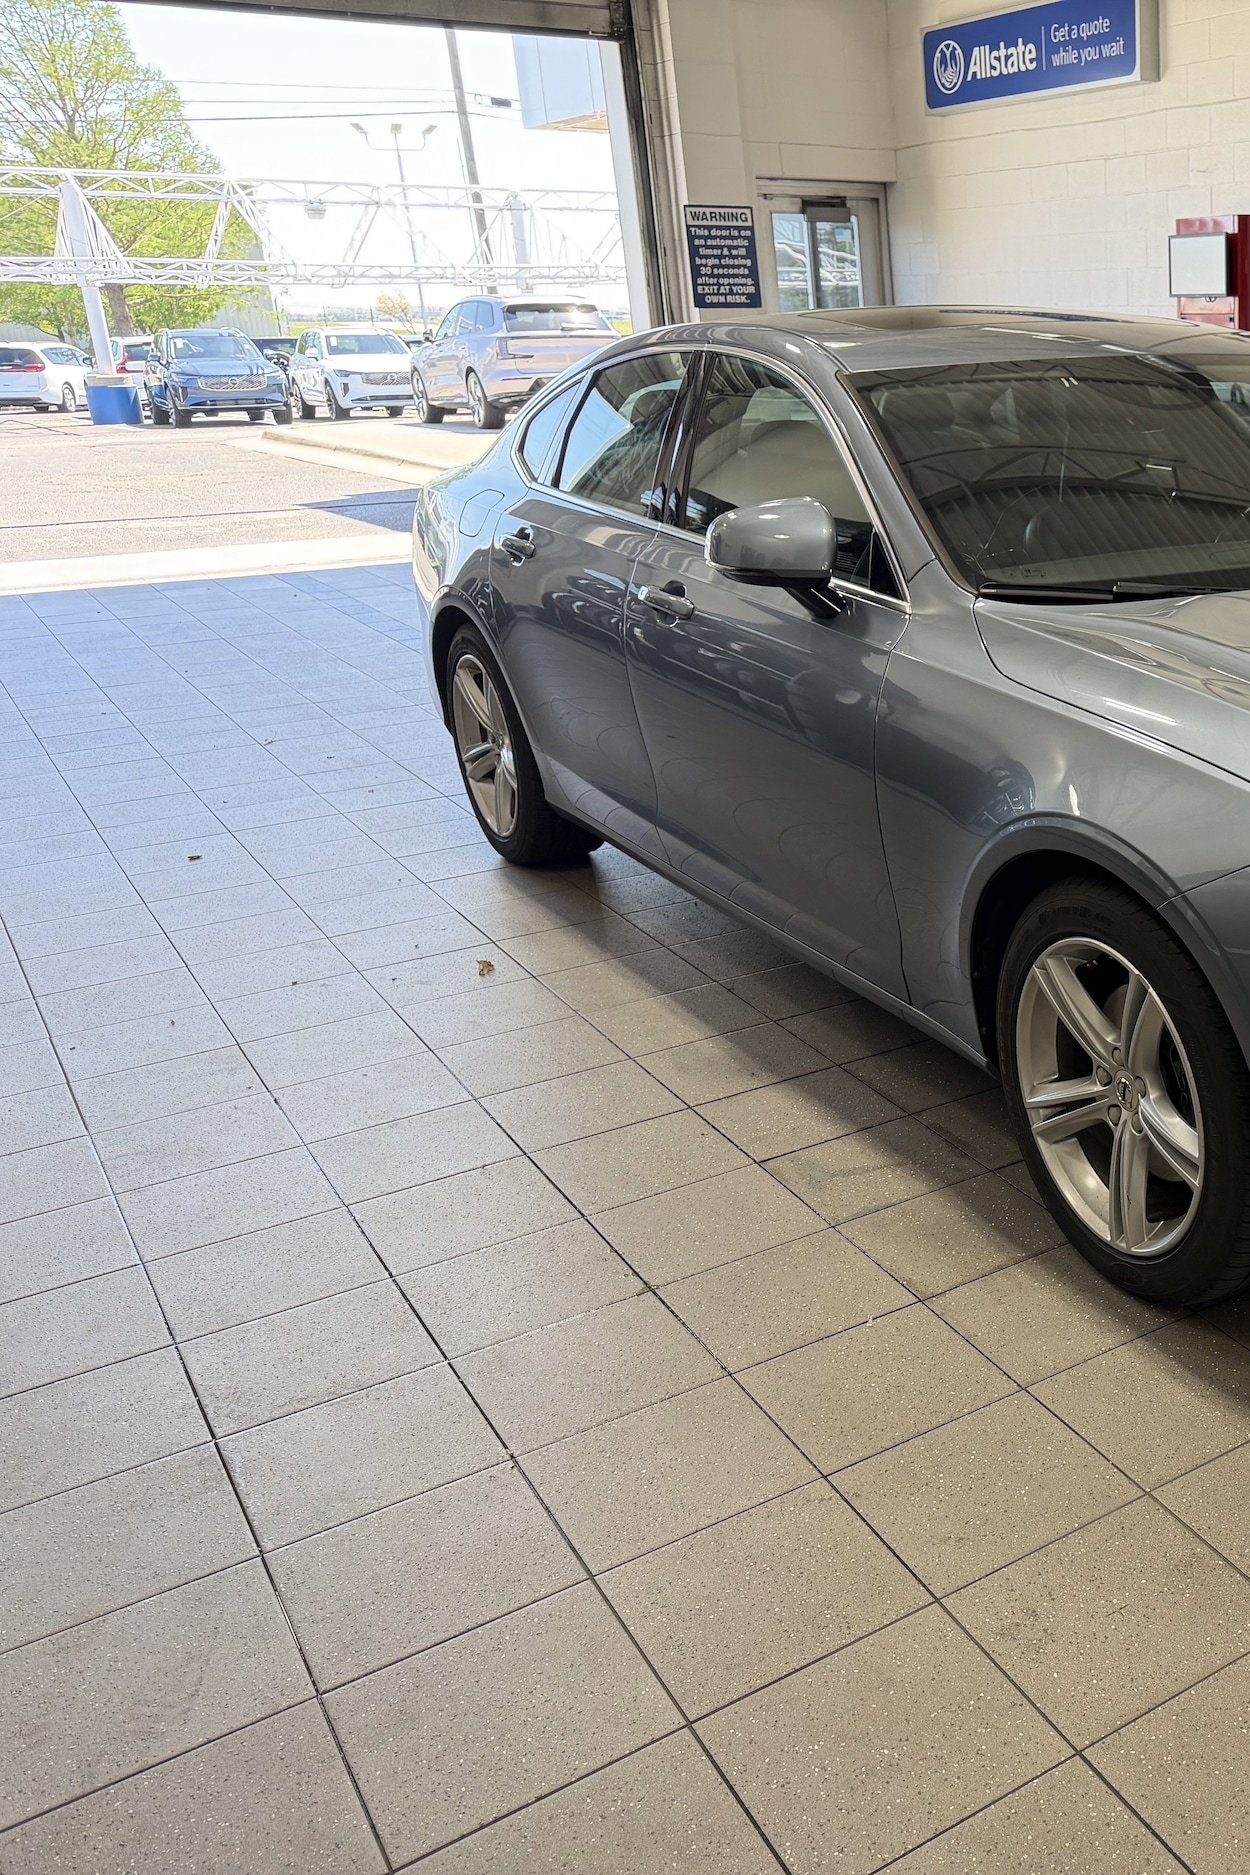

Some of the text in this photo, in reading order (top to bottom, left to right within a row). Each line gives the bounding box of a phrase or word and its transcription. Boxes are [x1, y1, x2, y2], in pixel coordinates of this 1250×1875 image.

[1050, 15, 1110, 43] Get a quote
[1051, 37, 1125, 67] while you wait
[966, 37, 1037, 81] Allstate
[689, 211, 748, 222] WARNING
[689, 227, 709, 236] This
[710, 228, 729, 236] door
[731, 228, 739, 236] is
[706, 238, 749, 246] automatic
[699, 247, 746, 255] timer & will
[695, 257, 751, 266] begin closing
[700, 266, 712, 274] 30
[697, 276, 717, 284] after
[705, 295, 751, 303] OWN RISK.
